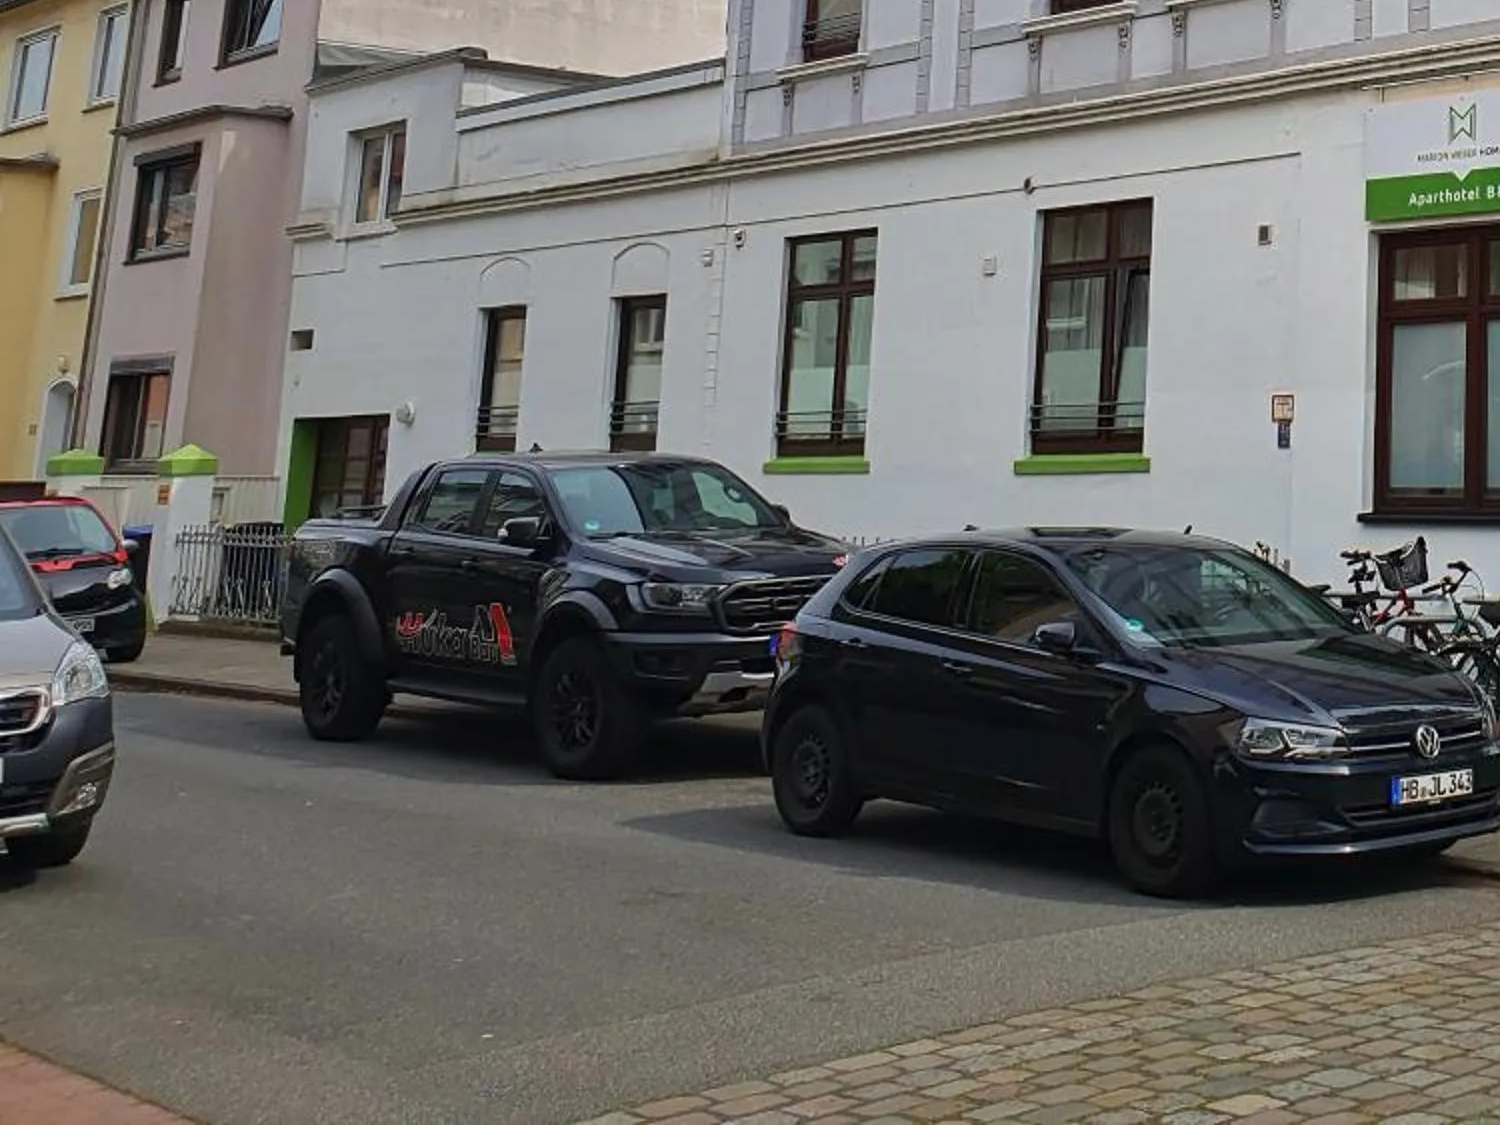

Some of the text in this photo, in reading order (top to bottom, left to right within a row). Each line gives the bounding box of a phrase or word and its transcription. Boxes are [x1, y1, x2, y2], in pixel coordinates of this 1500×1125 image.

[1408, 186, 1480, 208] Aparthotel
[1401, 779, 1419, 800] HB
[1429, 775, 1447, 796] JL
